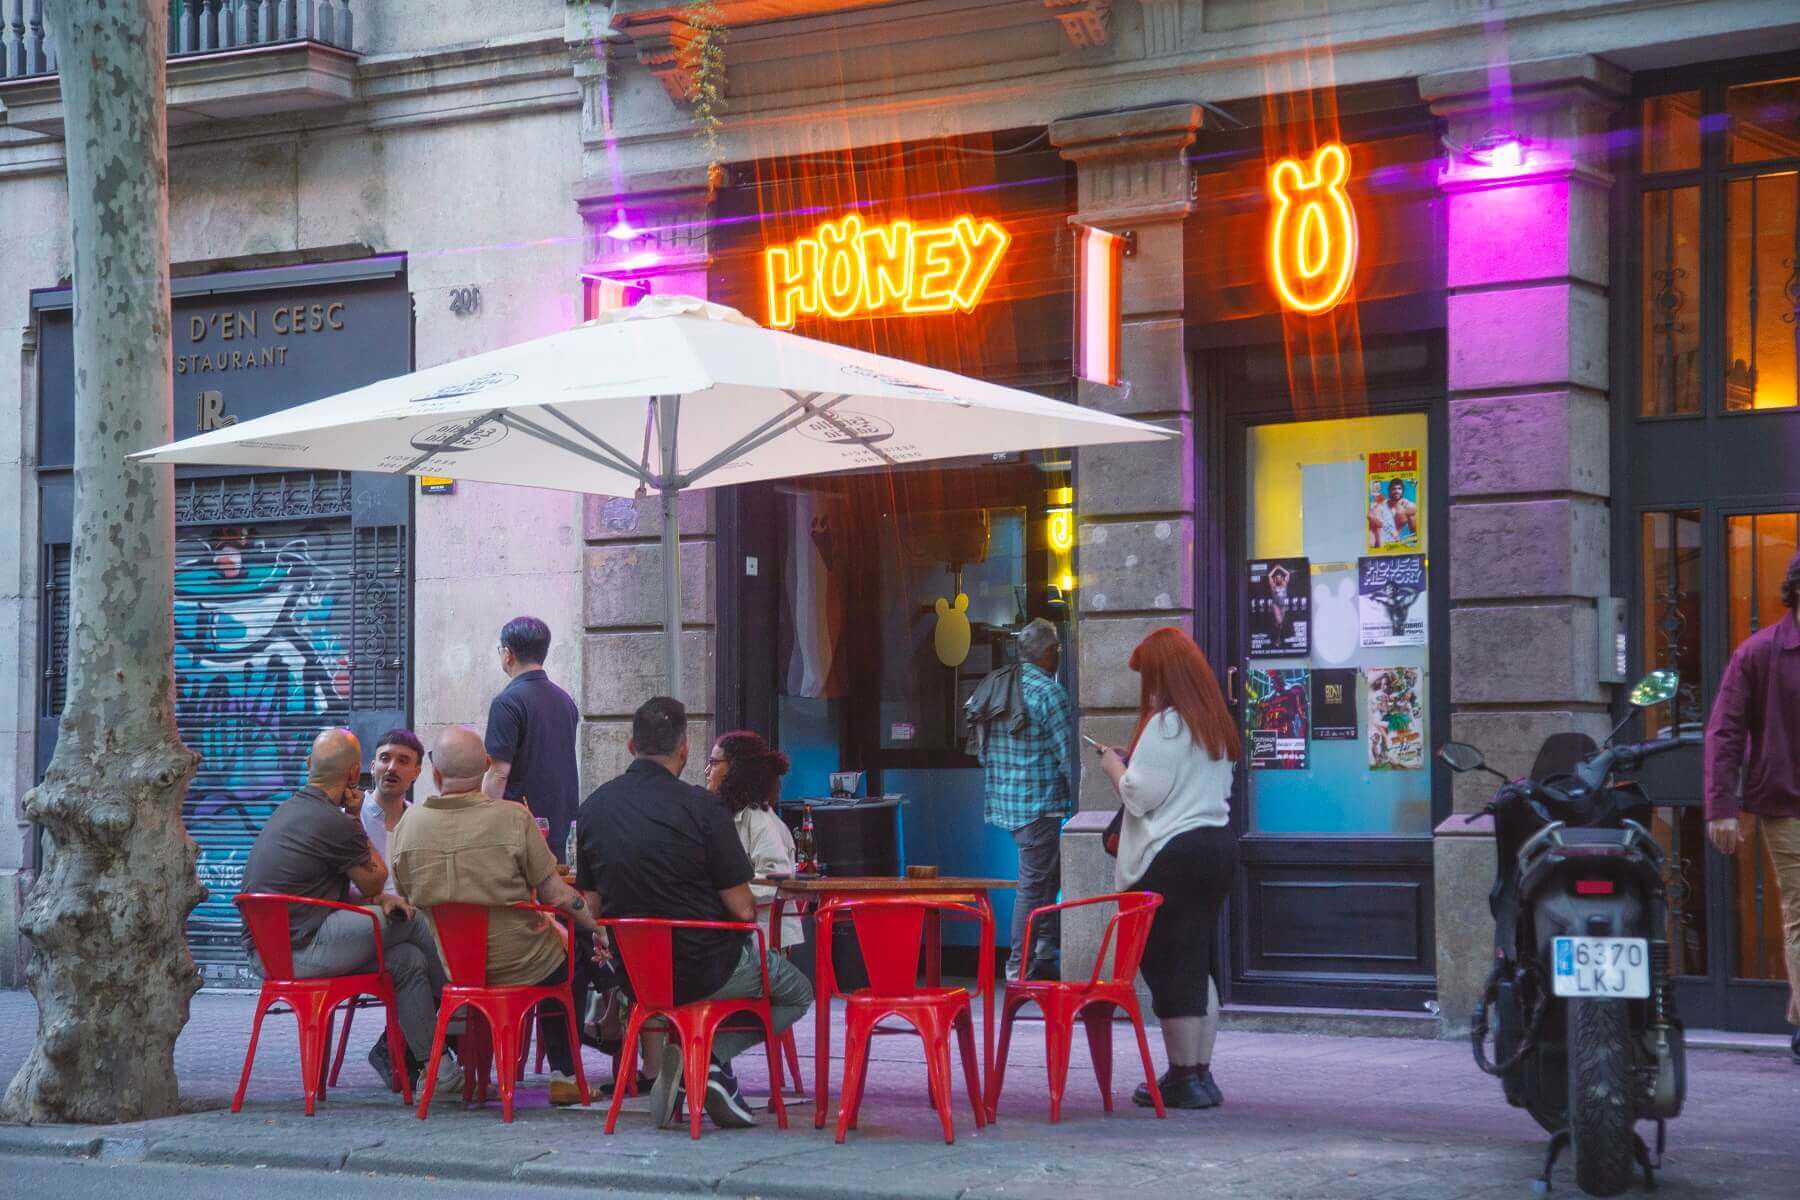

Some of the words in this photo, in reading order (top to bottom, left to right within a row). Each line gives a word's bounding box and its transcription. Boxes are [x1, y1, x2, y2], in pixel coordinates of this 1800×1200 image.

[191, 310, 258, 342] D'EN
[272, 303, 345, 334] CESC
[177, 346, 289, 375] STAURANT
[1366, 557, 1420, 574] HOUSE
[1364, 570, 1423, 586] HISTORY
[1576, 943, 1642, 967] 6370
[1577, 970, 1627, 992] LKJ
